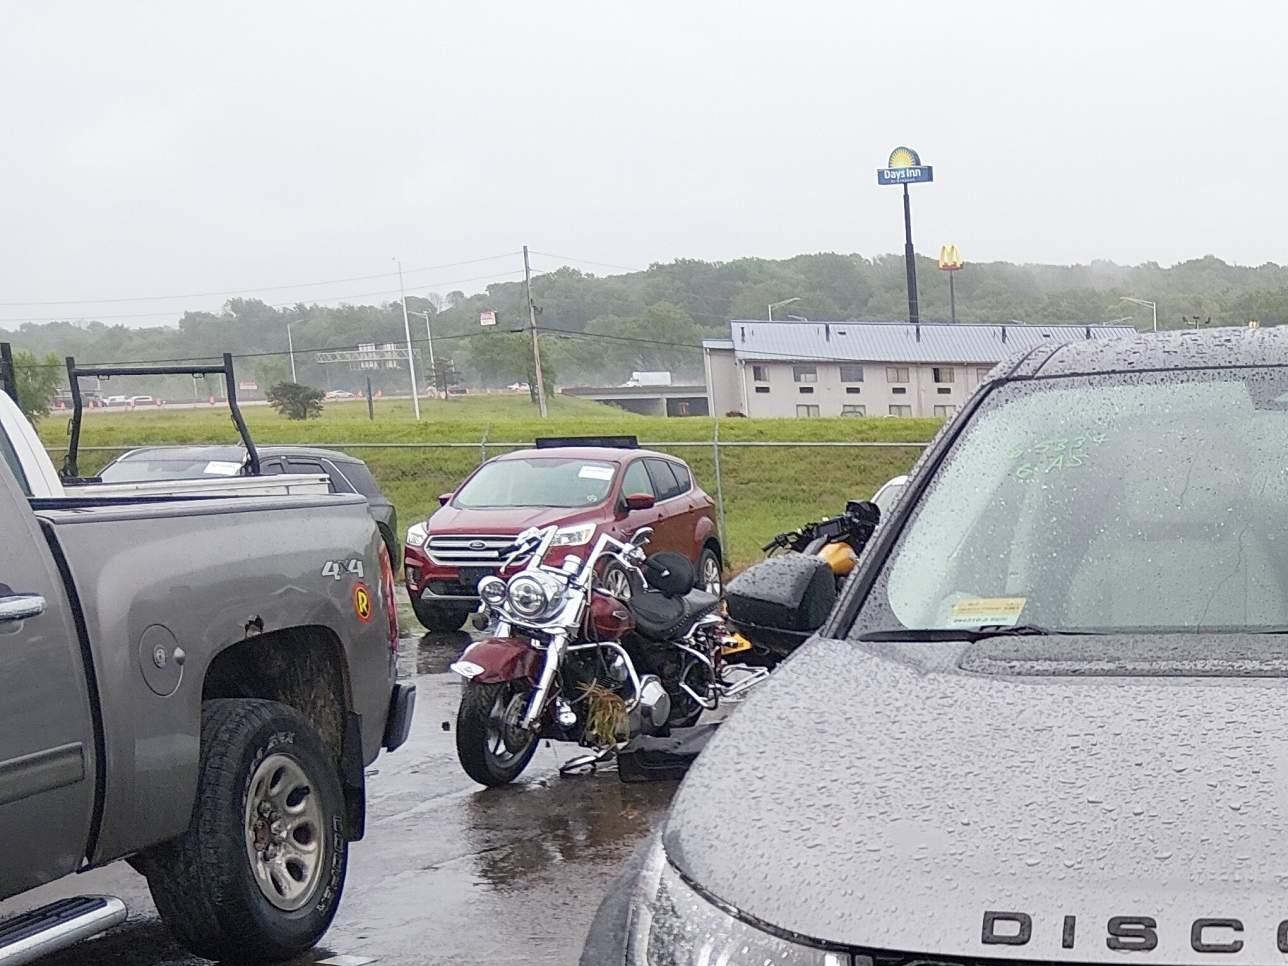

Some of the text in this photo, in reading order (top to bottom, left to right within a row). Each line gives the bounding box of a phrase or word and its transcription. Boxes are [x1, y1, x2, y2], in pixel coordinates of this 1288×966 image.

[884, 168, 921, 180] Days Inn
[357, 590, 368, 613] R
